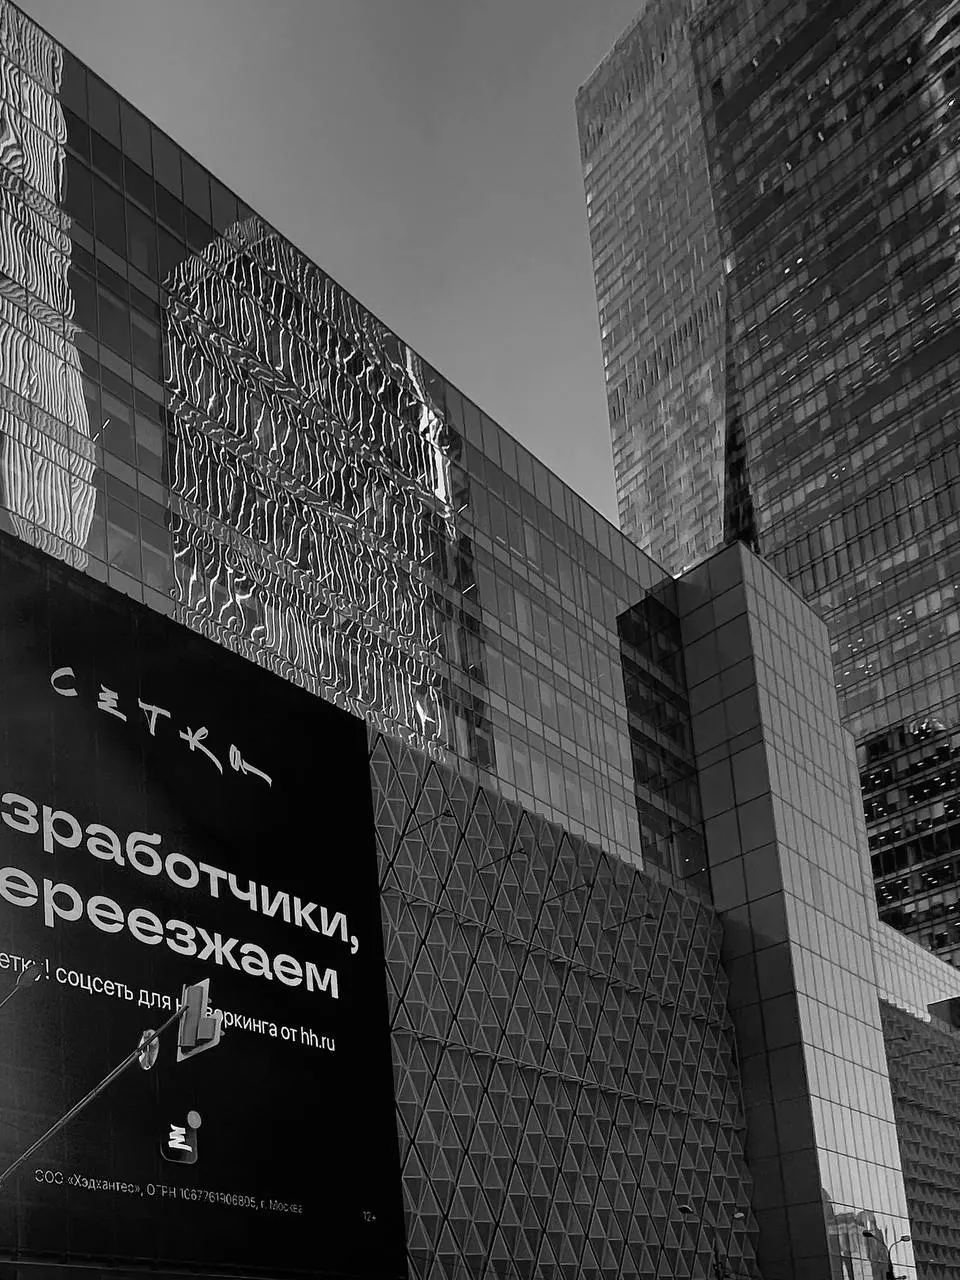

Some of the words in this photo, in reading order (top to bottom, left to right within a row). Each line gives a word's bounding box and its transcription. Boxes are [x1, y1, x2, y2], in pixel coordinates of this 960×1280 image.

[55, 967, 134, 1001] соцсеть
[138, 988, 172, 1011] для
[280, 1026, 298, 1042] от
[301, 1026, 336, 1052] hh.ru
